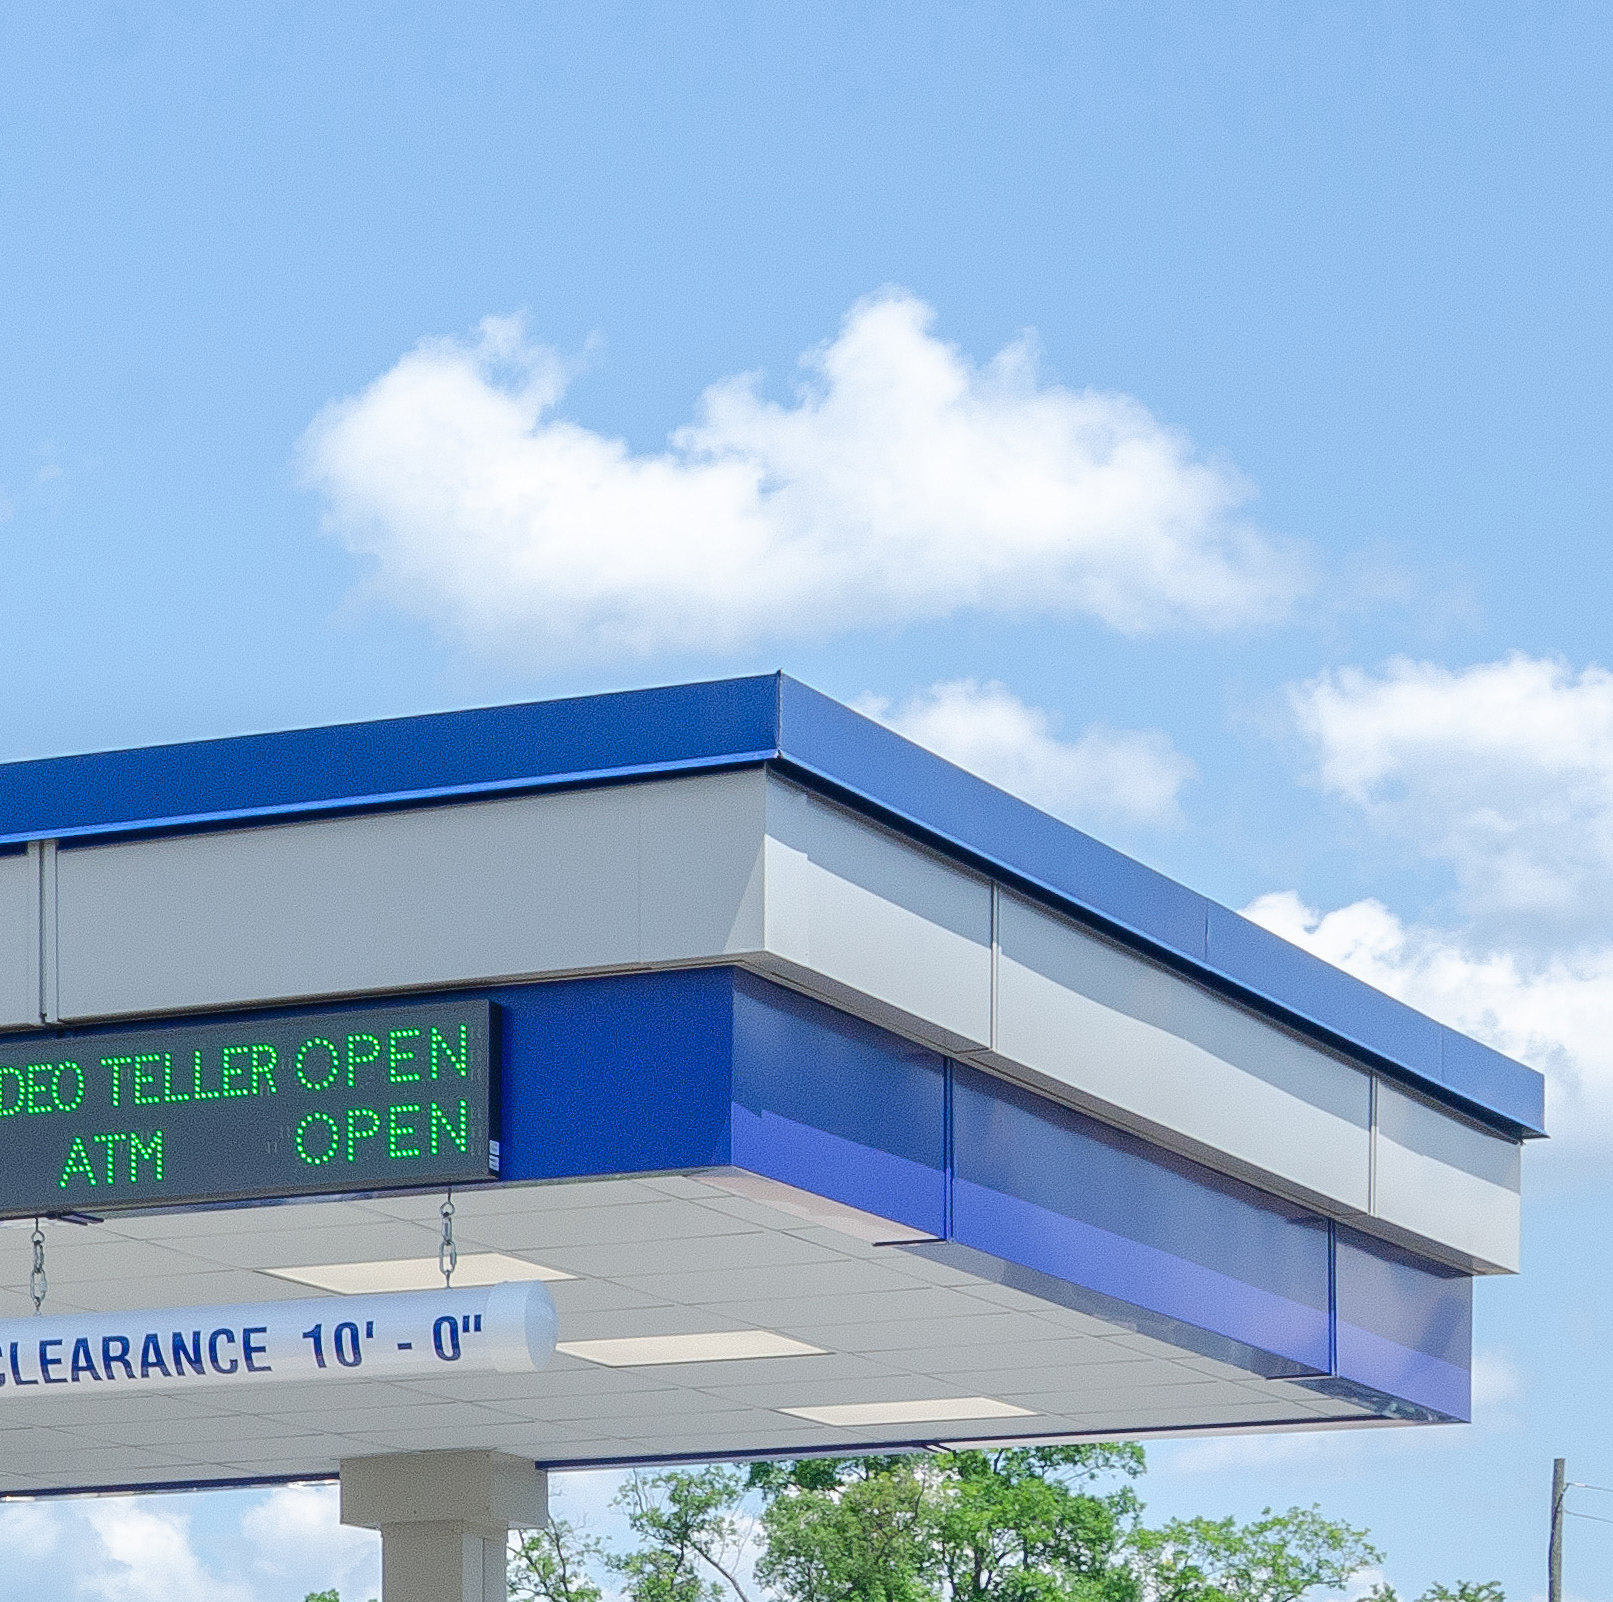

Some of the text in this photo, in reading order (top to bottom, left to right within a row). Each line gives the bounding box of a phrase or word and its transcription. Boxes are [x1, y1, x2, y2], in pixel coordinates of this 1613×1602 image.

[100, 1044, 278, 1107] TELLER
[295, 1024, 468, 1092] OPEN
[59, 1130, 165, 1188] ATM
[294, 1100, 468, 1166] OPEN
